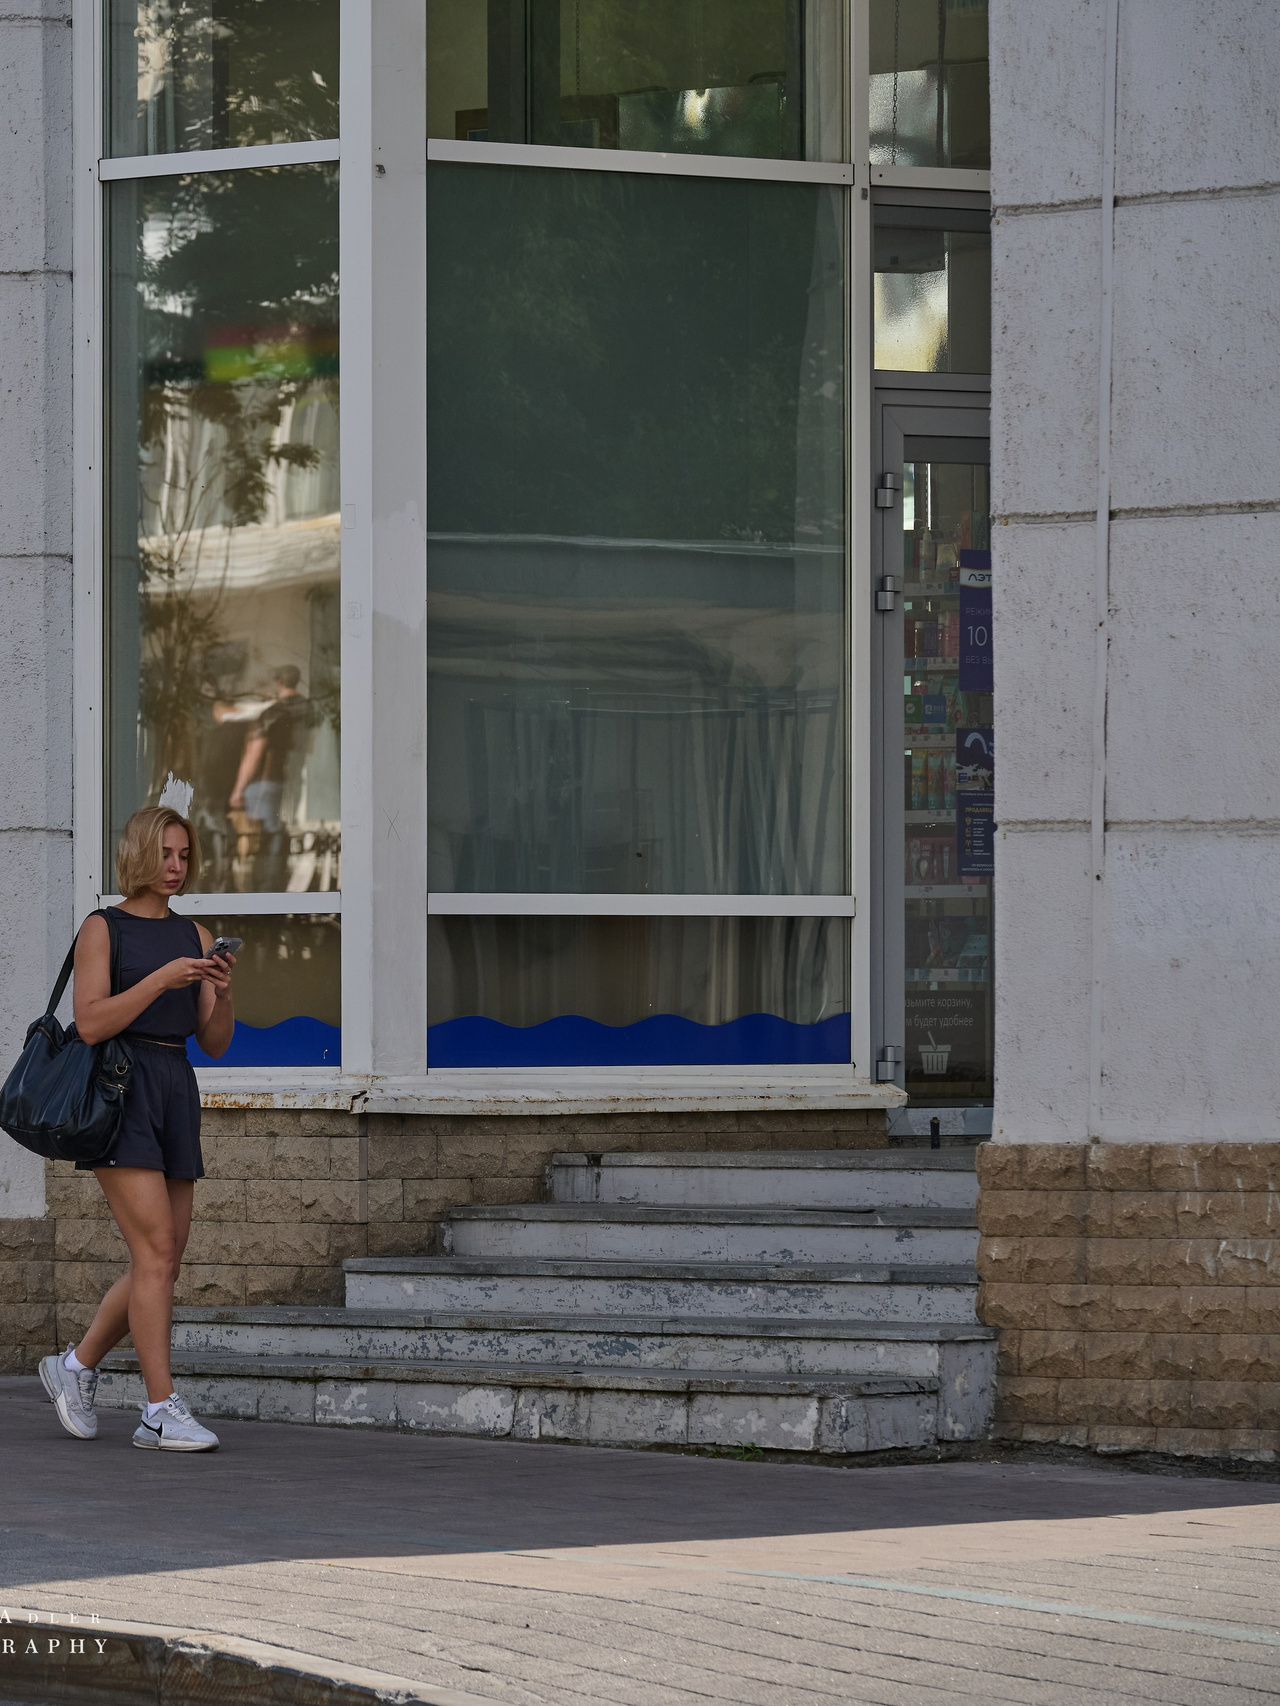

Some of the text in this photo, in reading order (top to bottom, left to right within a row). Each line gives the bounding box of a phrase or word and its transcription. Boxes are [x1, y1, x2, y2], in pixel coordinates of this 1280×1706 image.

[966, 607, 992, 616] РЕЖИ
[967, 625, 988, 647] 10
[966, 655, 980, 664] БЕЗ
[937, 998, 973, 1010] корзину,
[914, 1014, 938, 1029] будет
[939, 1014, 974, 1029] удобнее
